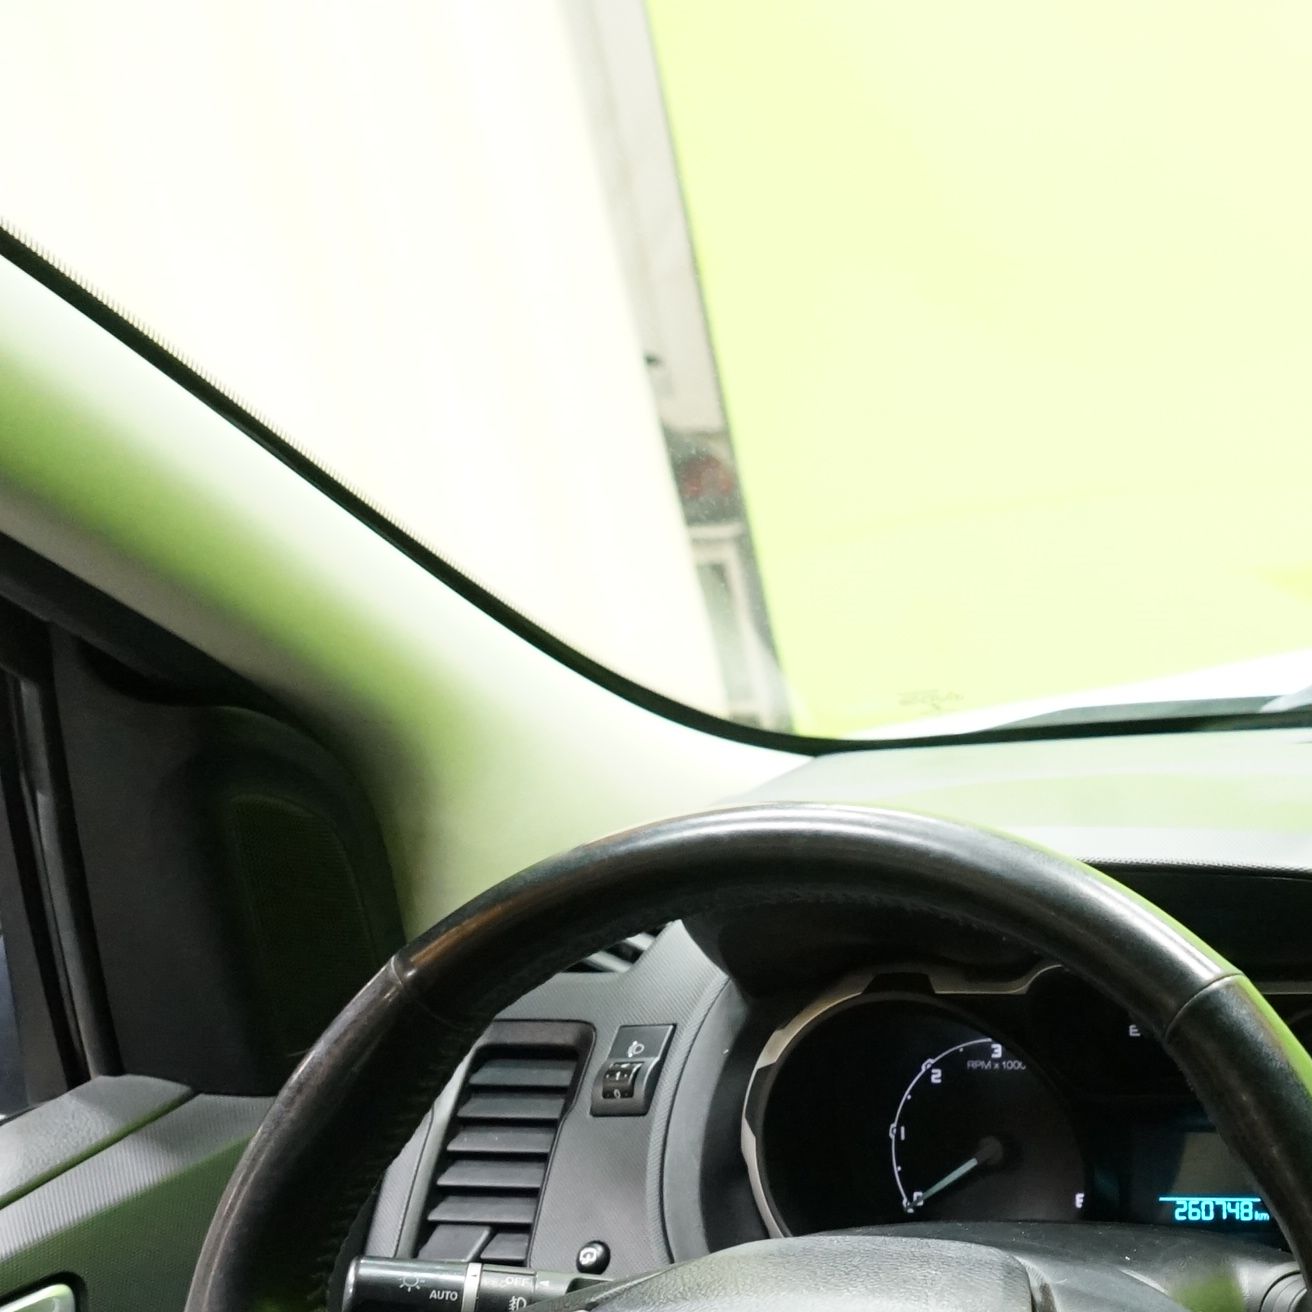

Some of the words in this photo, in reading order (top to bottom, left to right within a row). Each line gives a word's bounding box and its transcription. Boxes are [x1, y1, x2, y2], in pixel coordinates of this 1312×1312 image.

[991, 1043, 1003, 1058] 3
[966, 1060, 991, 1070] RPM
[930, 1068, 942, 1084] 2
[900, 1125, 906, 1141] 1
[429, 1290, 458, 1302] AUTO
